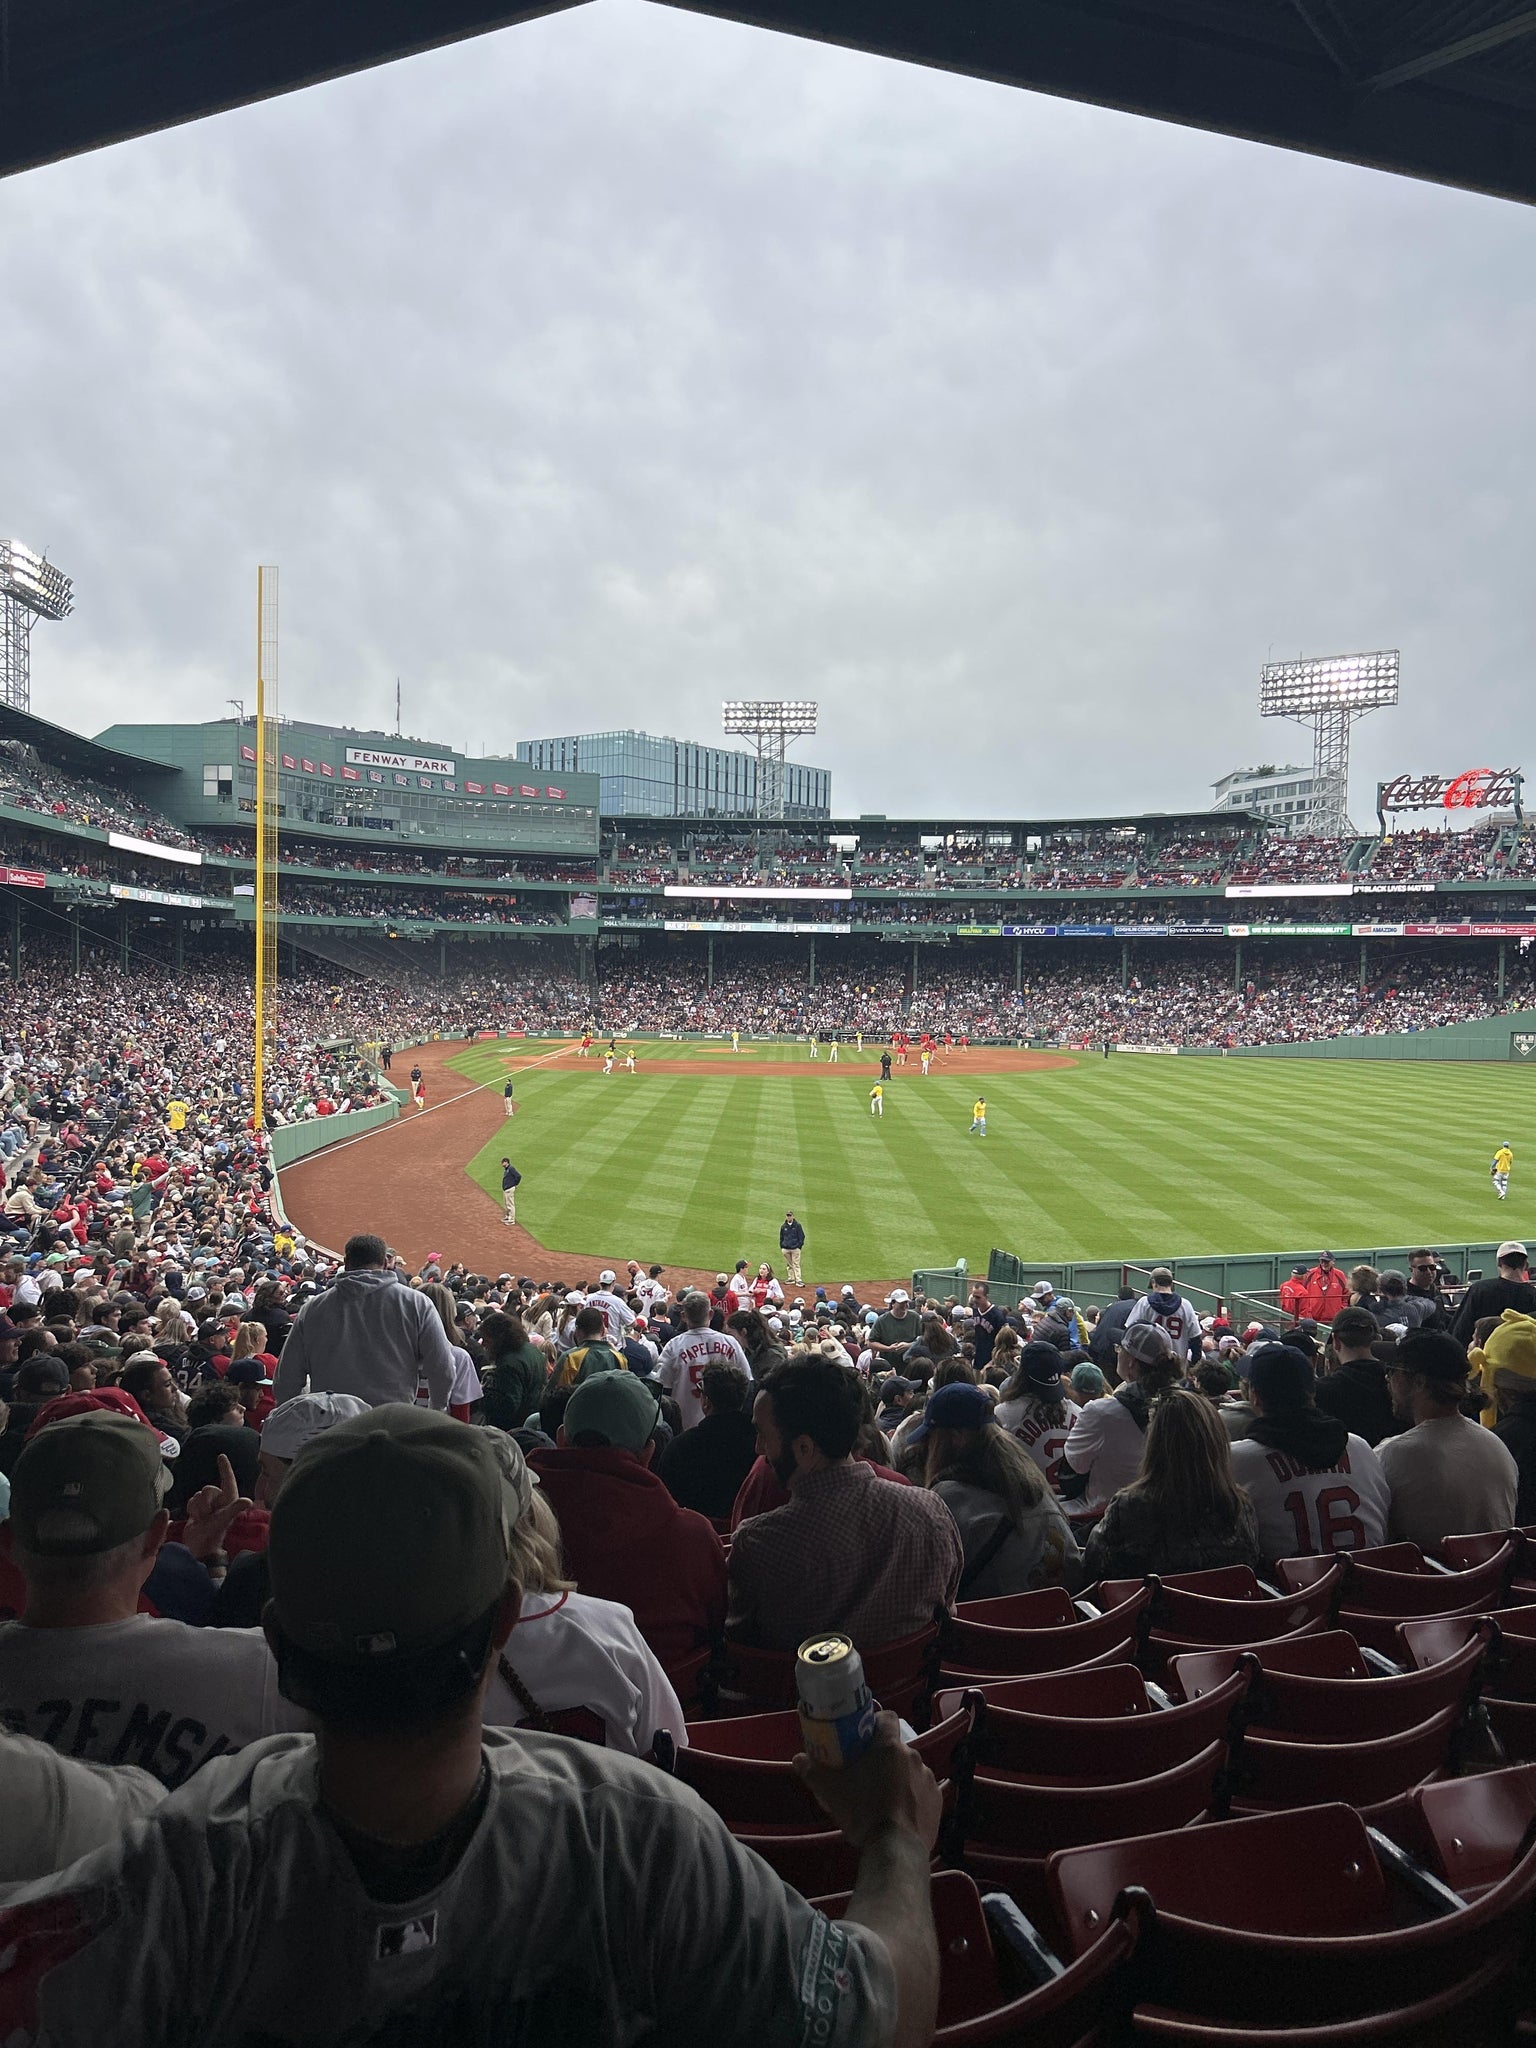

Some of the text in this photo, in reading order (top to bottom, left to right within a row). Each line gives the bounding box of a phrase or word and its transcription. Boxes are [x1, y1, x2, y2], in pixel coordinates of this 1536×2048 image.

[354, 752, 448, 772] FENWAY PARK
[1407, 884, 1435, 892] MATTER
[680, 1342, 735, 1365] PAPELBON
[1284, 1486, 1367, 1553] 16
